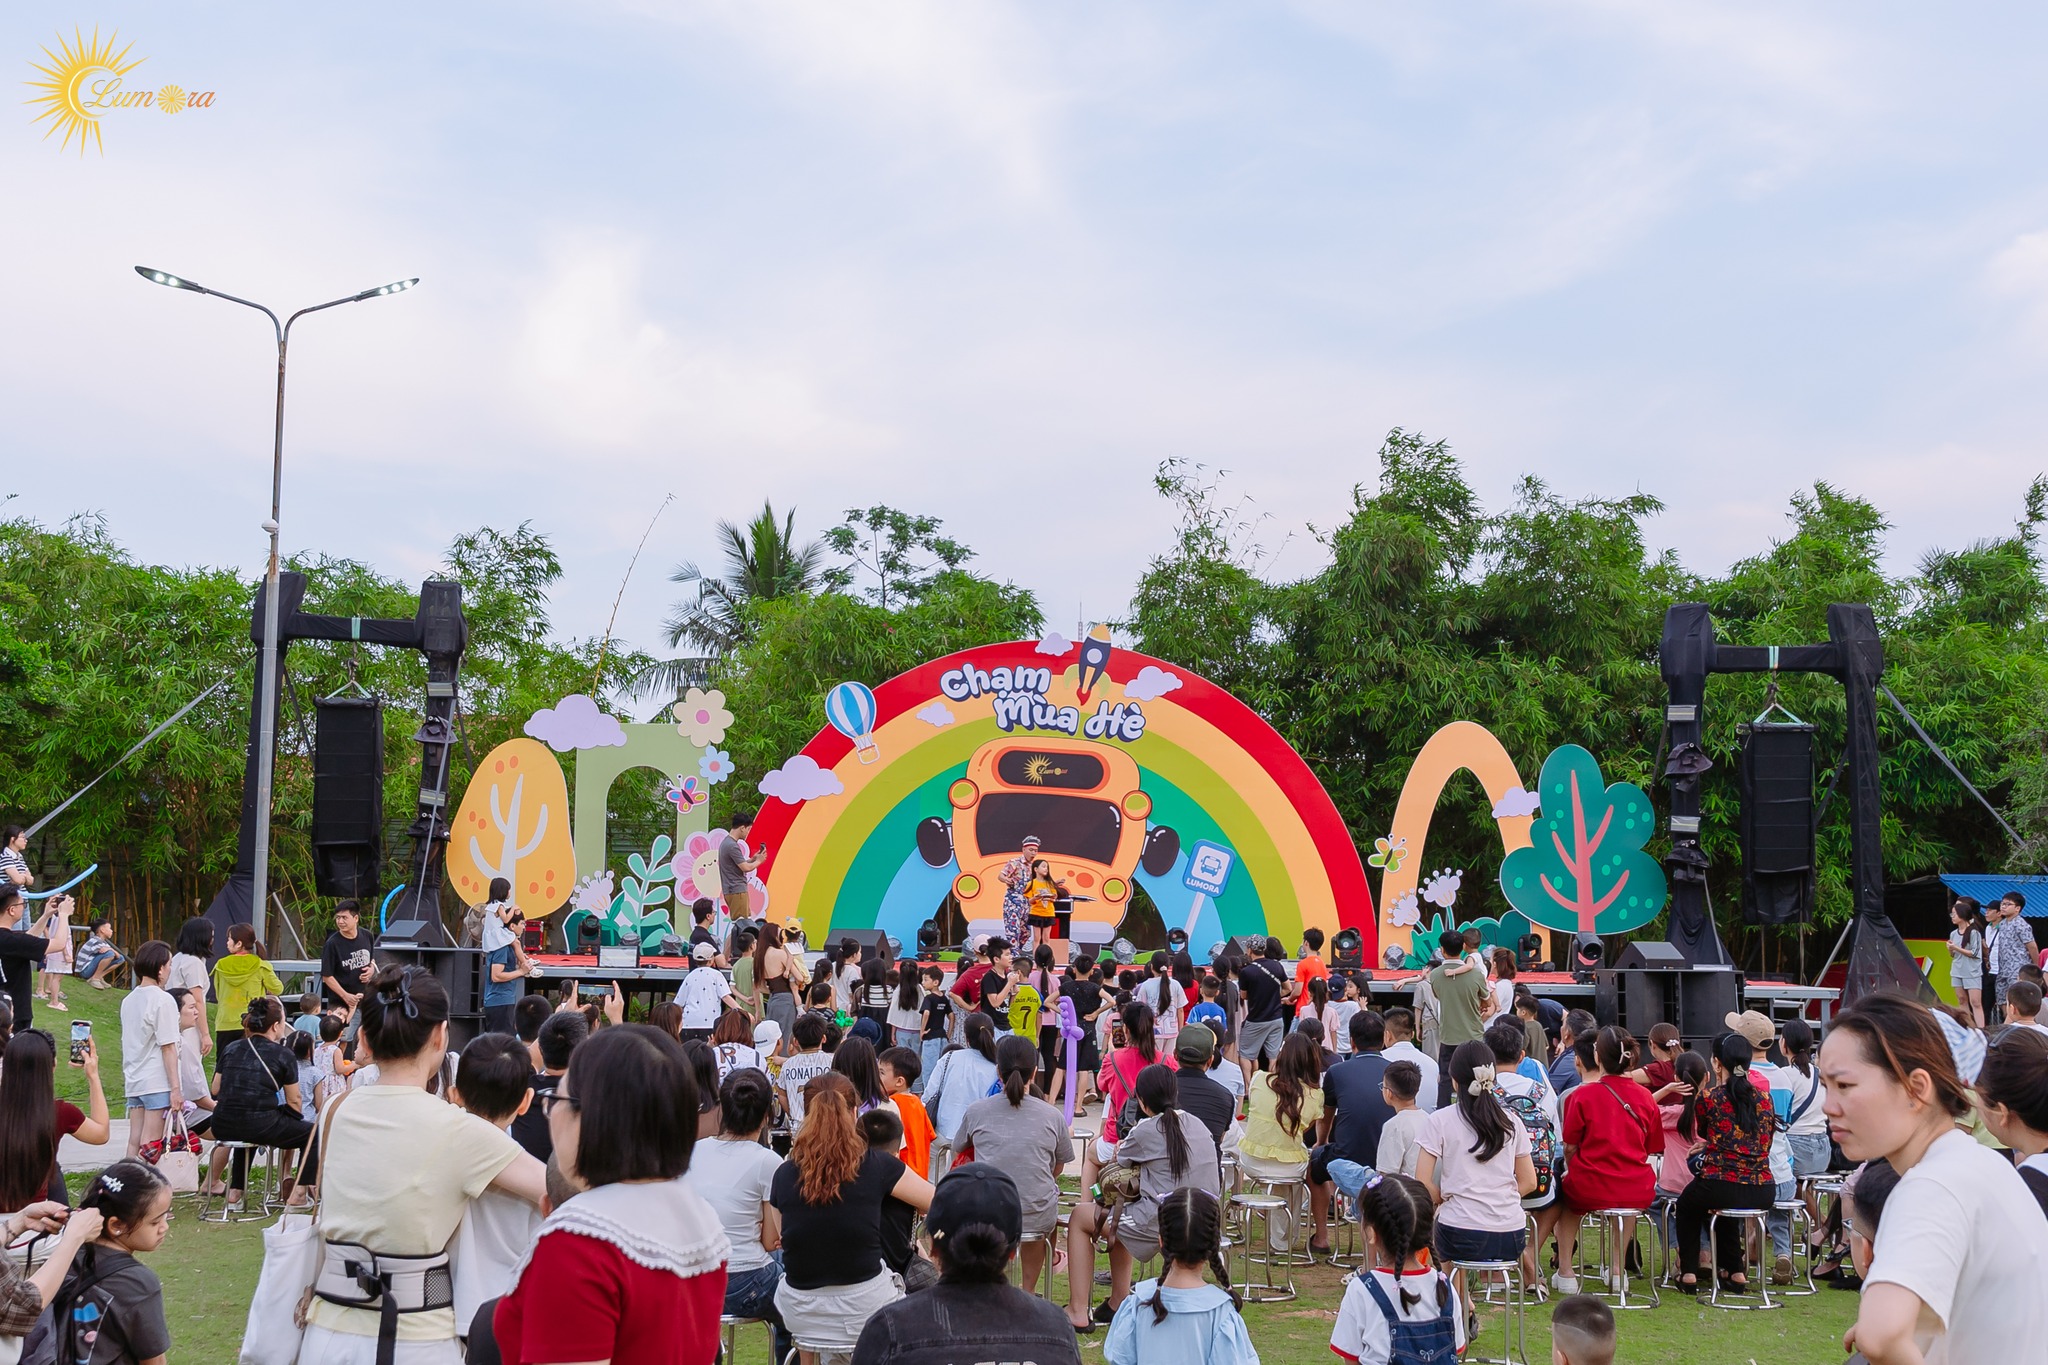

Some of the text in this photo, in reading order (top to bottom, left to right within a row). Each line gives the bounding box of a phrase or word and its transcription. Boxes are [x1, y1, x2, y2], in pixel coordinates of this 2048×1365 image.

[993, 694, 1147, 742] Mùa Hè
[1186, 877, 1220, 894] LUMORA
[342, 957, 363, 967] NORTH
[350, 950, 363, 959] THE
[350, 961, 365, 970] FACE
[1020, 1005, 1032, 1030] 7
[785, 1066, 831, 1081] RONALDO
